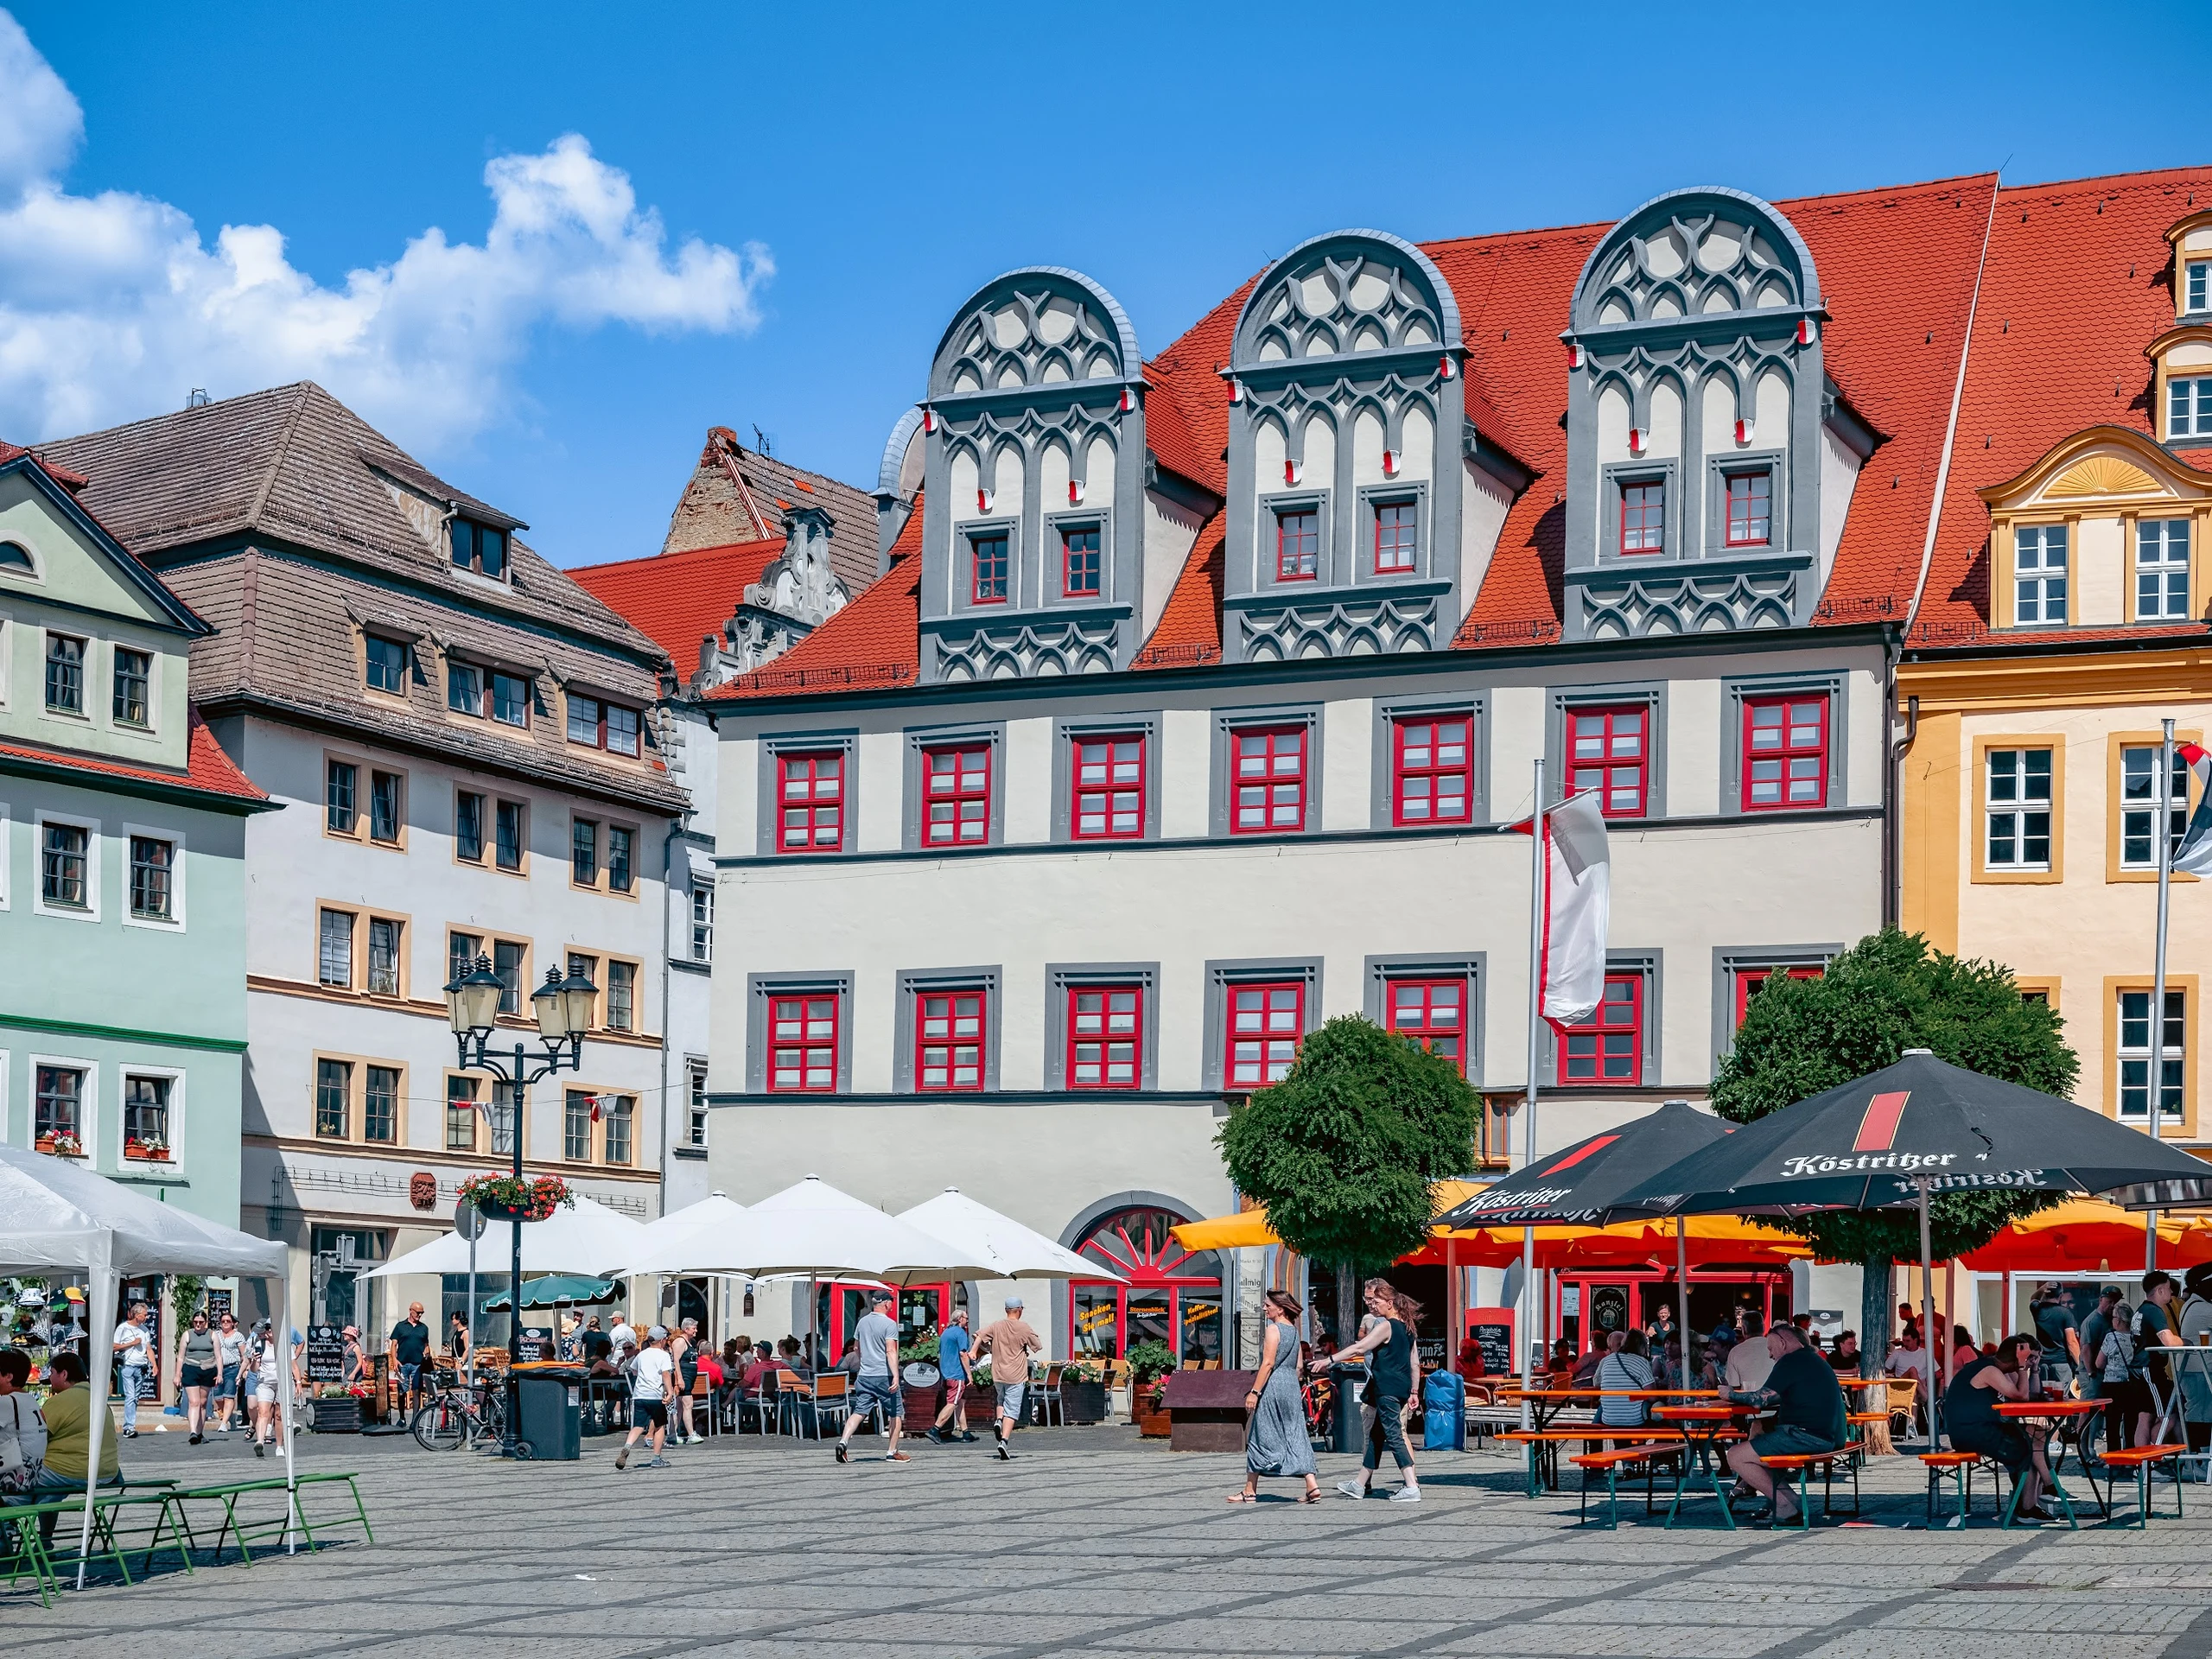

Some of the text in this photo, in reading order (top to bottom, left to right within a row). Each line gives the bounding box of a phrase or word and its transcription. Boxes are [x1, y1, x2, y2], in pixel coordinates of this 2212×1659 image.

[1780, 1152, 1958, 1177] Köstritzer
[1451, 1186, 1572, 1217] Köstritzer
[1079, 1303, 1111, 1321] Snacken
[1595, 1300, 1624, 1312] Kanzlei
[1082, 1322, 1096, 1332] Sie
